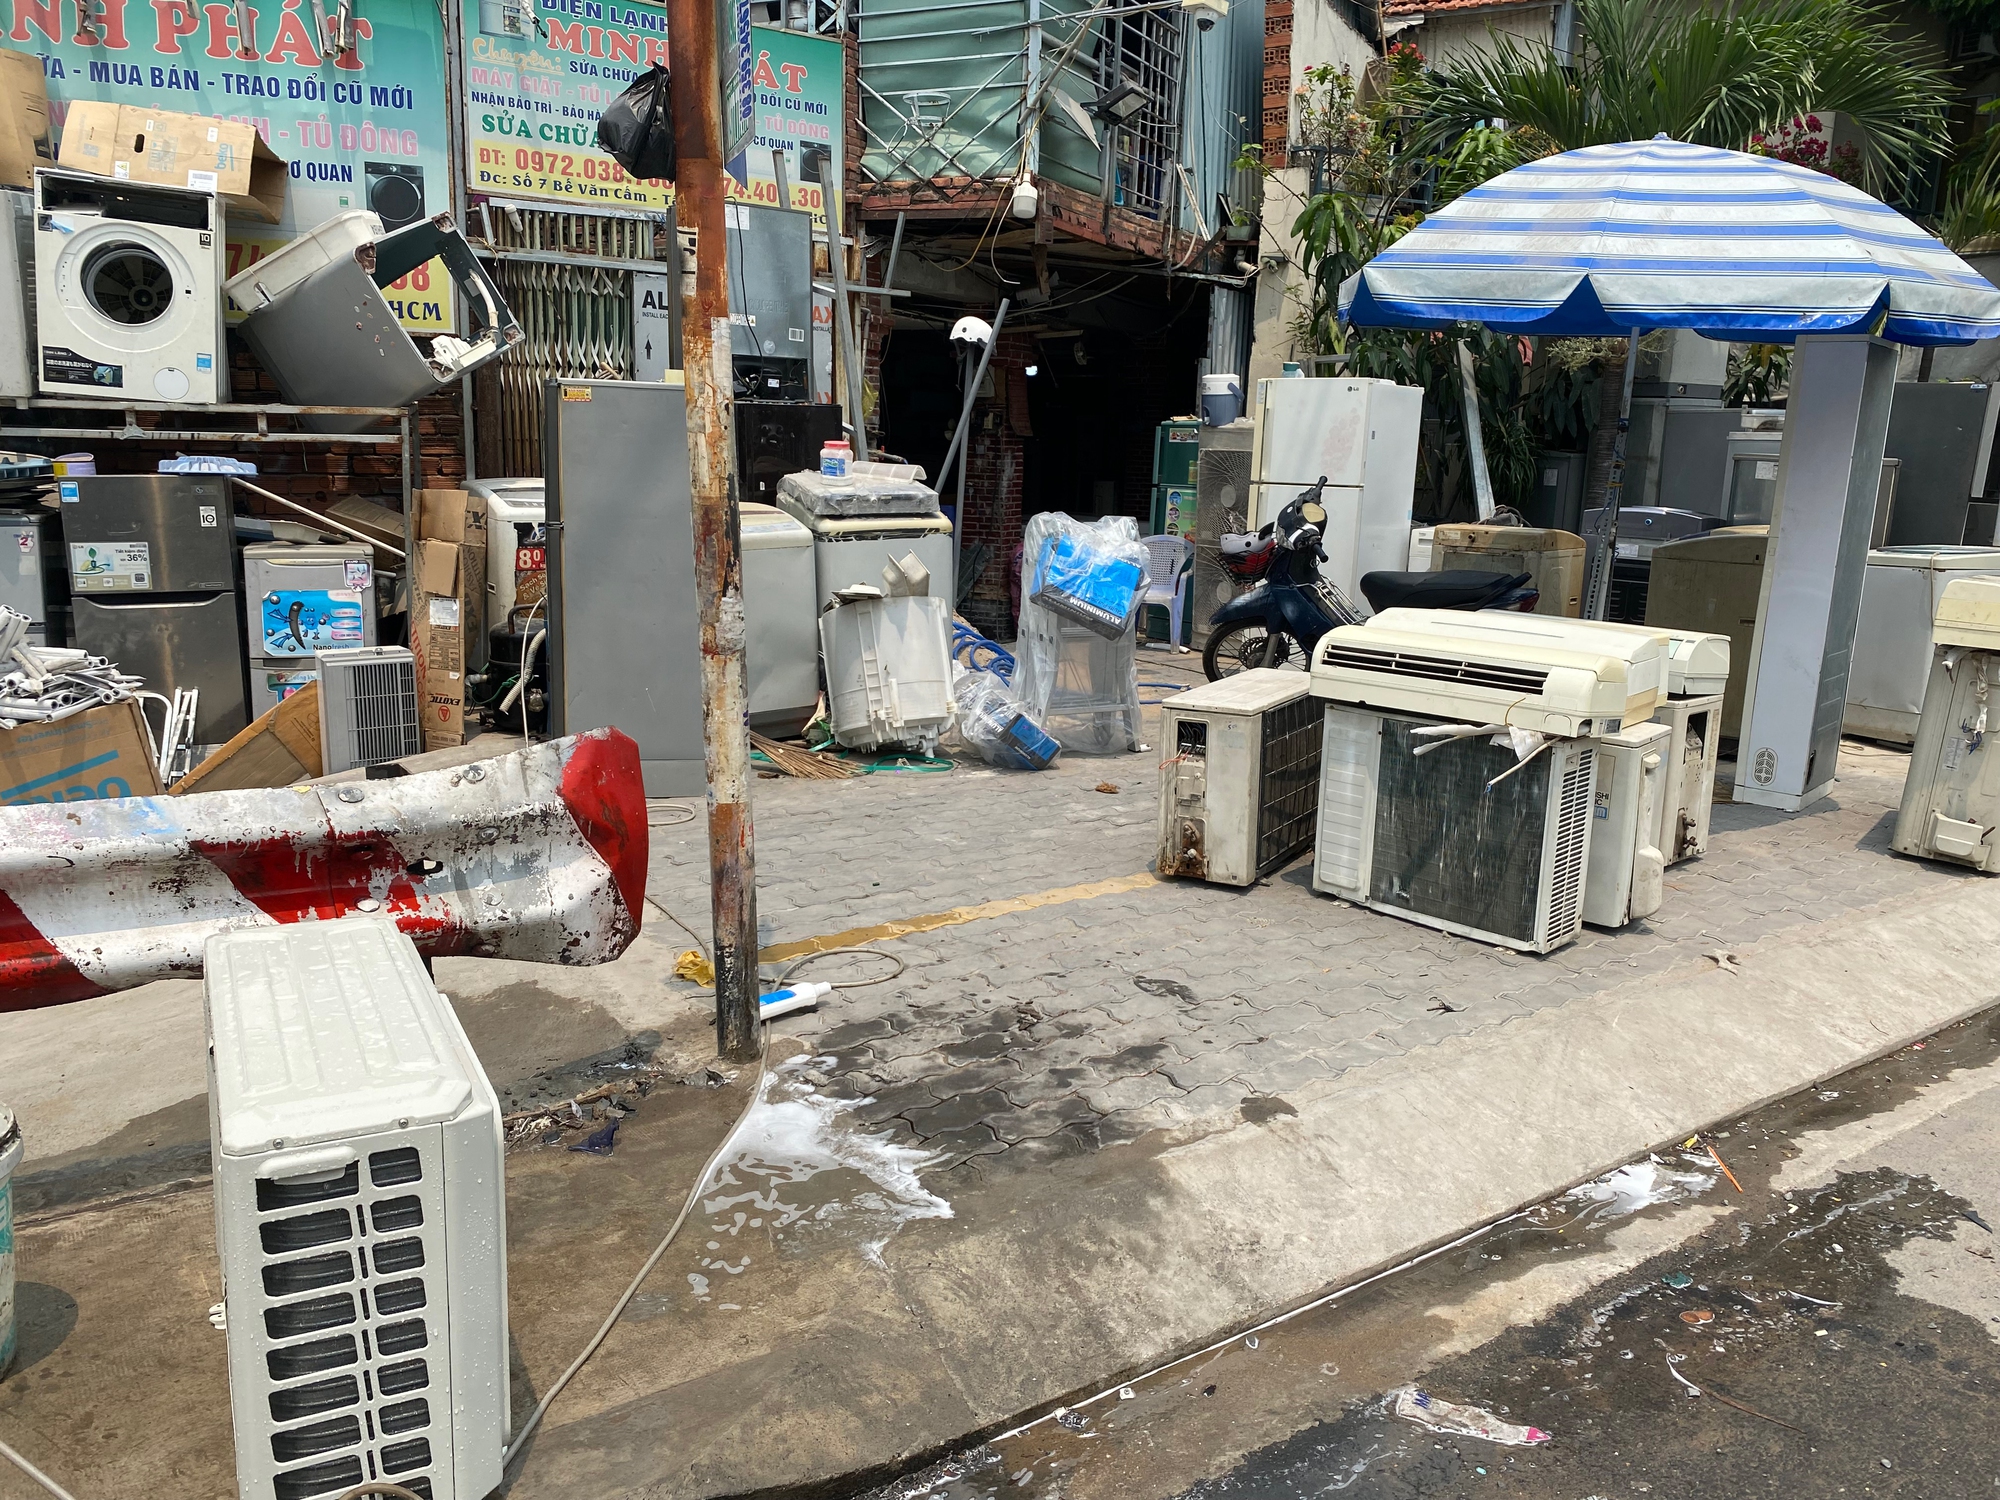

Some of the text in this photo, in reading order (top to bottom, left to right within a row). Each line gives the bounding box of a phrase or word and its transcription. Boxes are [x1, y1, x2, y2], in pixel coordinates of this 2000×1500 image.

[546, 18, 808, 93] MINH ÁT
[89, 61, 143, 86] MUA
[150, 64, 200, 91] BÁN
[222, 73, 280, 97] TRAO
[287, 72, 326, 102] ĐỔI
[333, 80, 363, 105] CŨ
[370, 83, 413, 110] MỚI
[570, 58, 599, 77] SỬA
[760, 91, 781, 108] ĐỔI
[785, 97, 801, 110] CŨ
[804, 101, 828, 116] MỚI
[471, 67, 514, 89] MÁY
[520, 75, 562, 97] GIẶT
[579, 83, 600, 103] TỦ
[765, 114, 783, 132] TỦ
[788, 119, 829, 139] ĐÔNG
[297, 114, 331, 149] TỦ
[340, 120, 418, 156] ĐÔNG
[471, 91, 504, 107] NHẬN
[508, 94, 531, 111] BẢO
[534, 99, 552, 114] TRÌ
[562, 104, 584, 119] BẢO
[768, 139, 794, 151] QUAN
[482, 110, 533, 139] SỬA
[215, 143, 229, 171] beko
[479, 147, 506, 166] ĐT:
[306, 162, 353, 182] QUAN
[479, 170, 507, 185] Đc:
[512, 172, 533, 188] Số
[539, 178, 547, 190] 7
[553, 177, 574, 193] Bế
[578, 183, 609, 198] Văn
[127, 553, 147, 562] 36%
[1069, 597, 1122, 625] ALUMINIUM
[430, 696, 461, 706] EXOTIC
